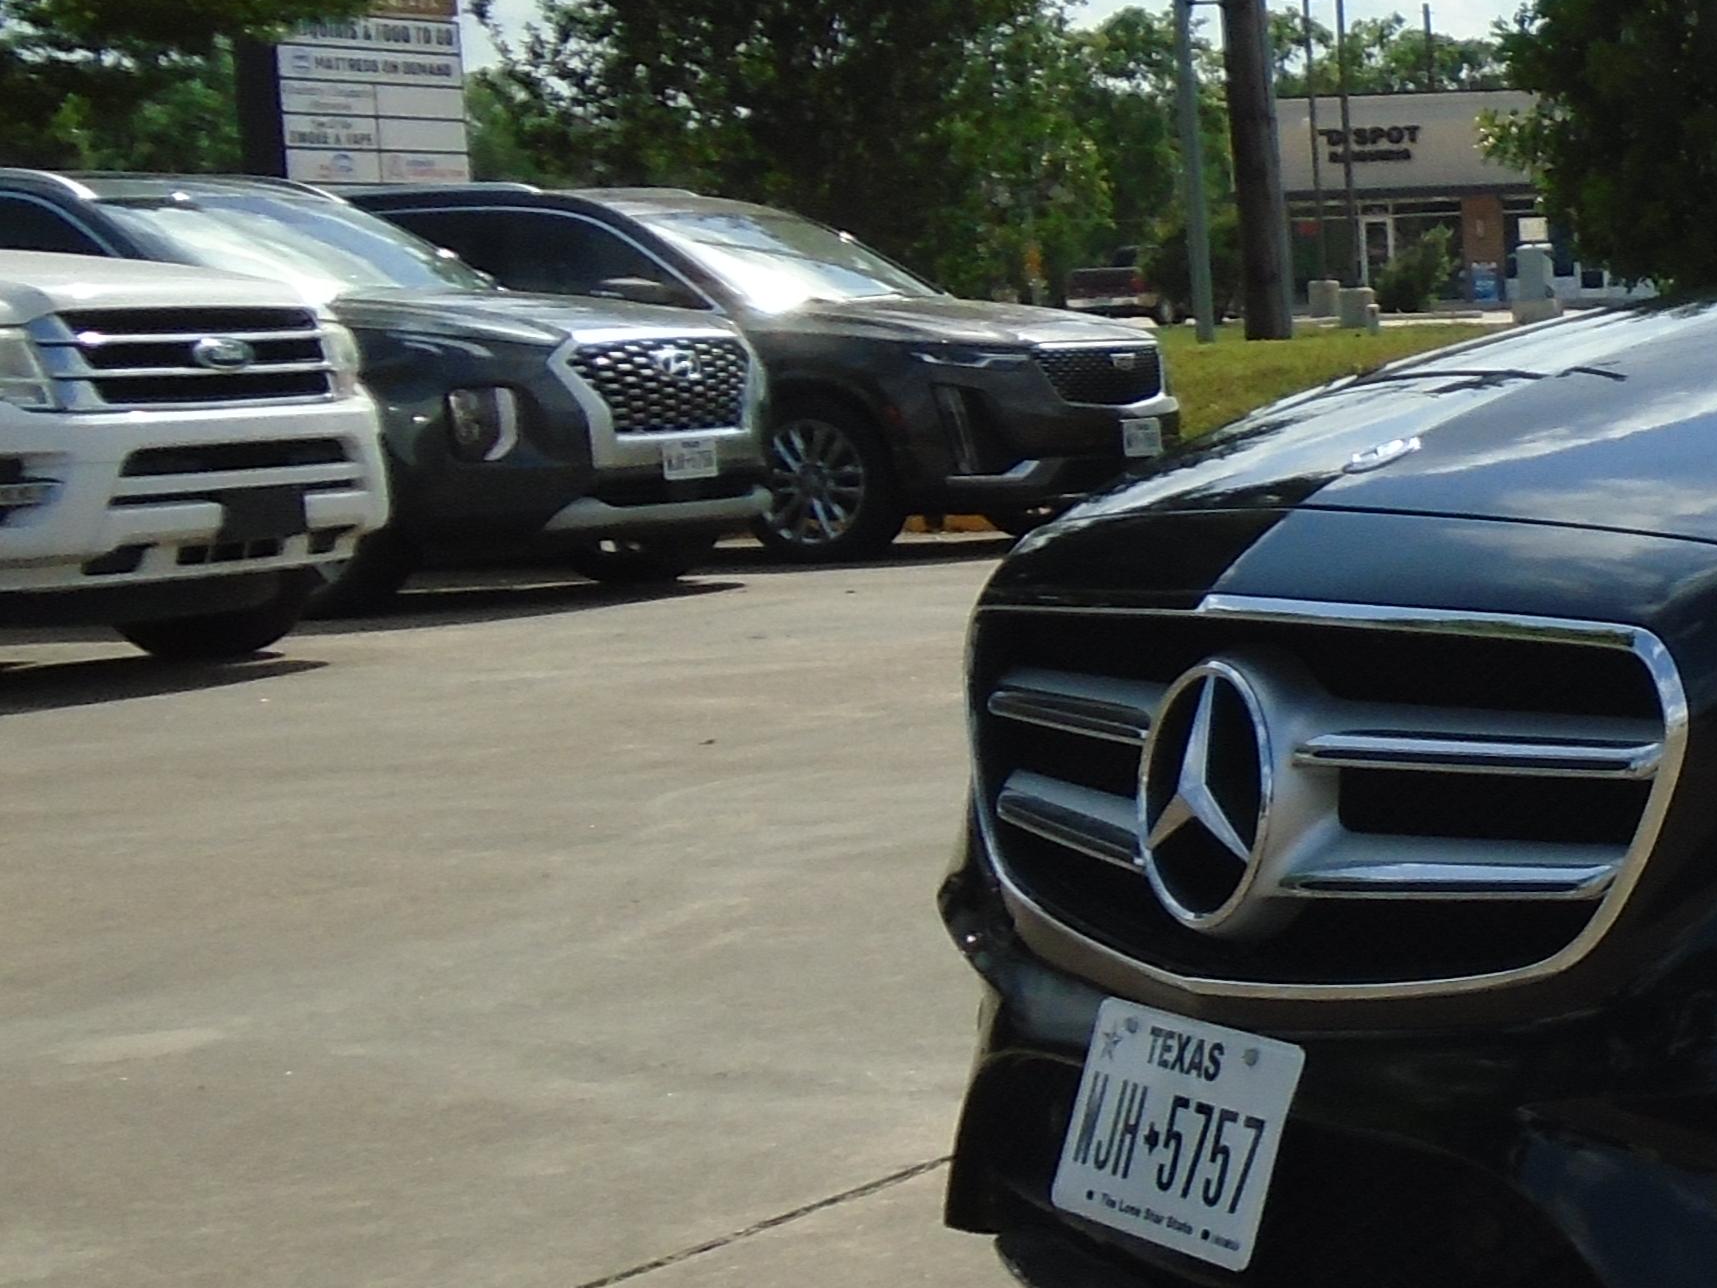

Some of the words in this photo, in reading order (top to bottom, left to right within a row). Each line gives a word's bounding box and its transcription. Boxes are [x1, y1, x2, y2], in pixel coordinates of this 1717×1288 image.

[315, 55, 379, 74] MATTRESS
[382, 59, 400, 74] ON
[403, 60, 452, 78] DEMAND
[1353, 125, 1421, 145] SPOT
[1147, 1026, 1225, 1082] TEXAS
[1118, 1199, 1142, 1217] Lone
[1143, 1208, 1165, 1225] Star
[1166, 1215, 1193, 1235] State
